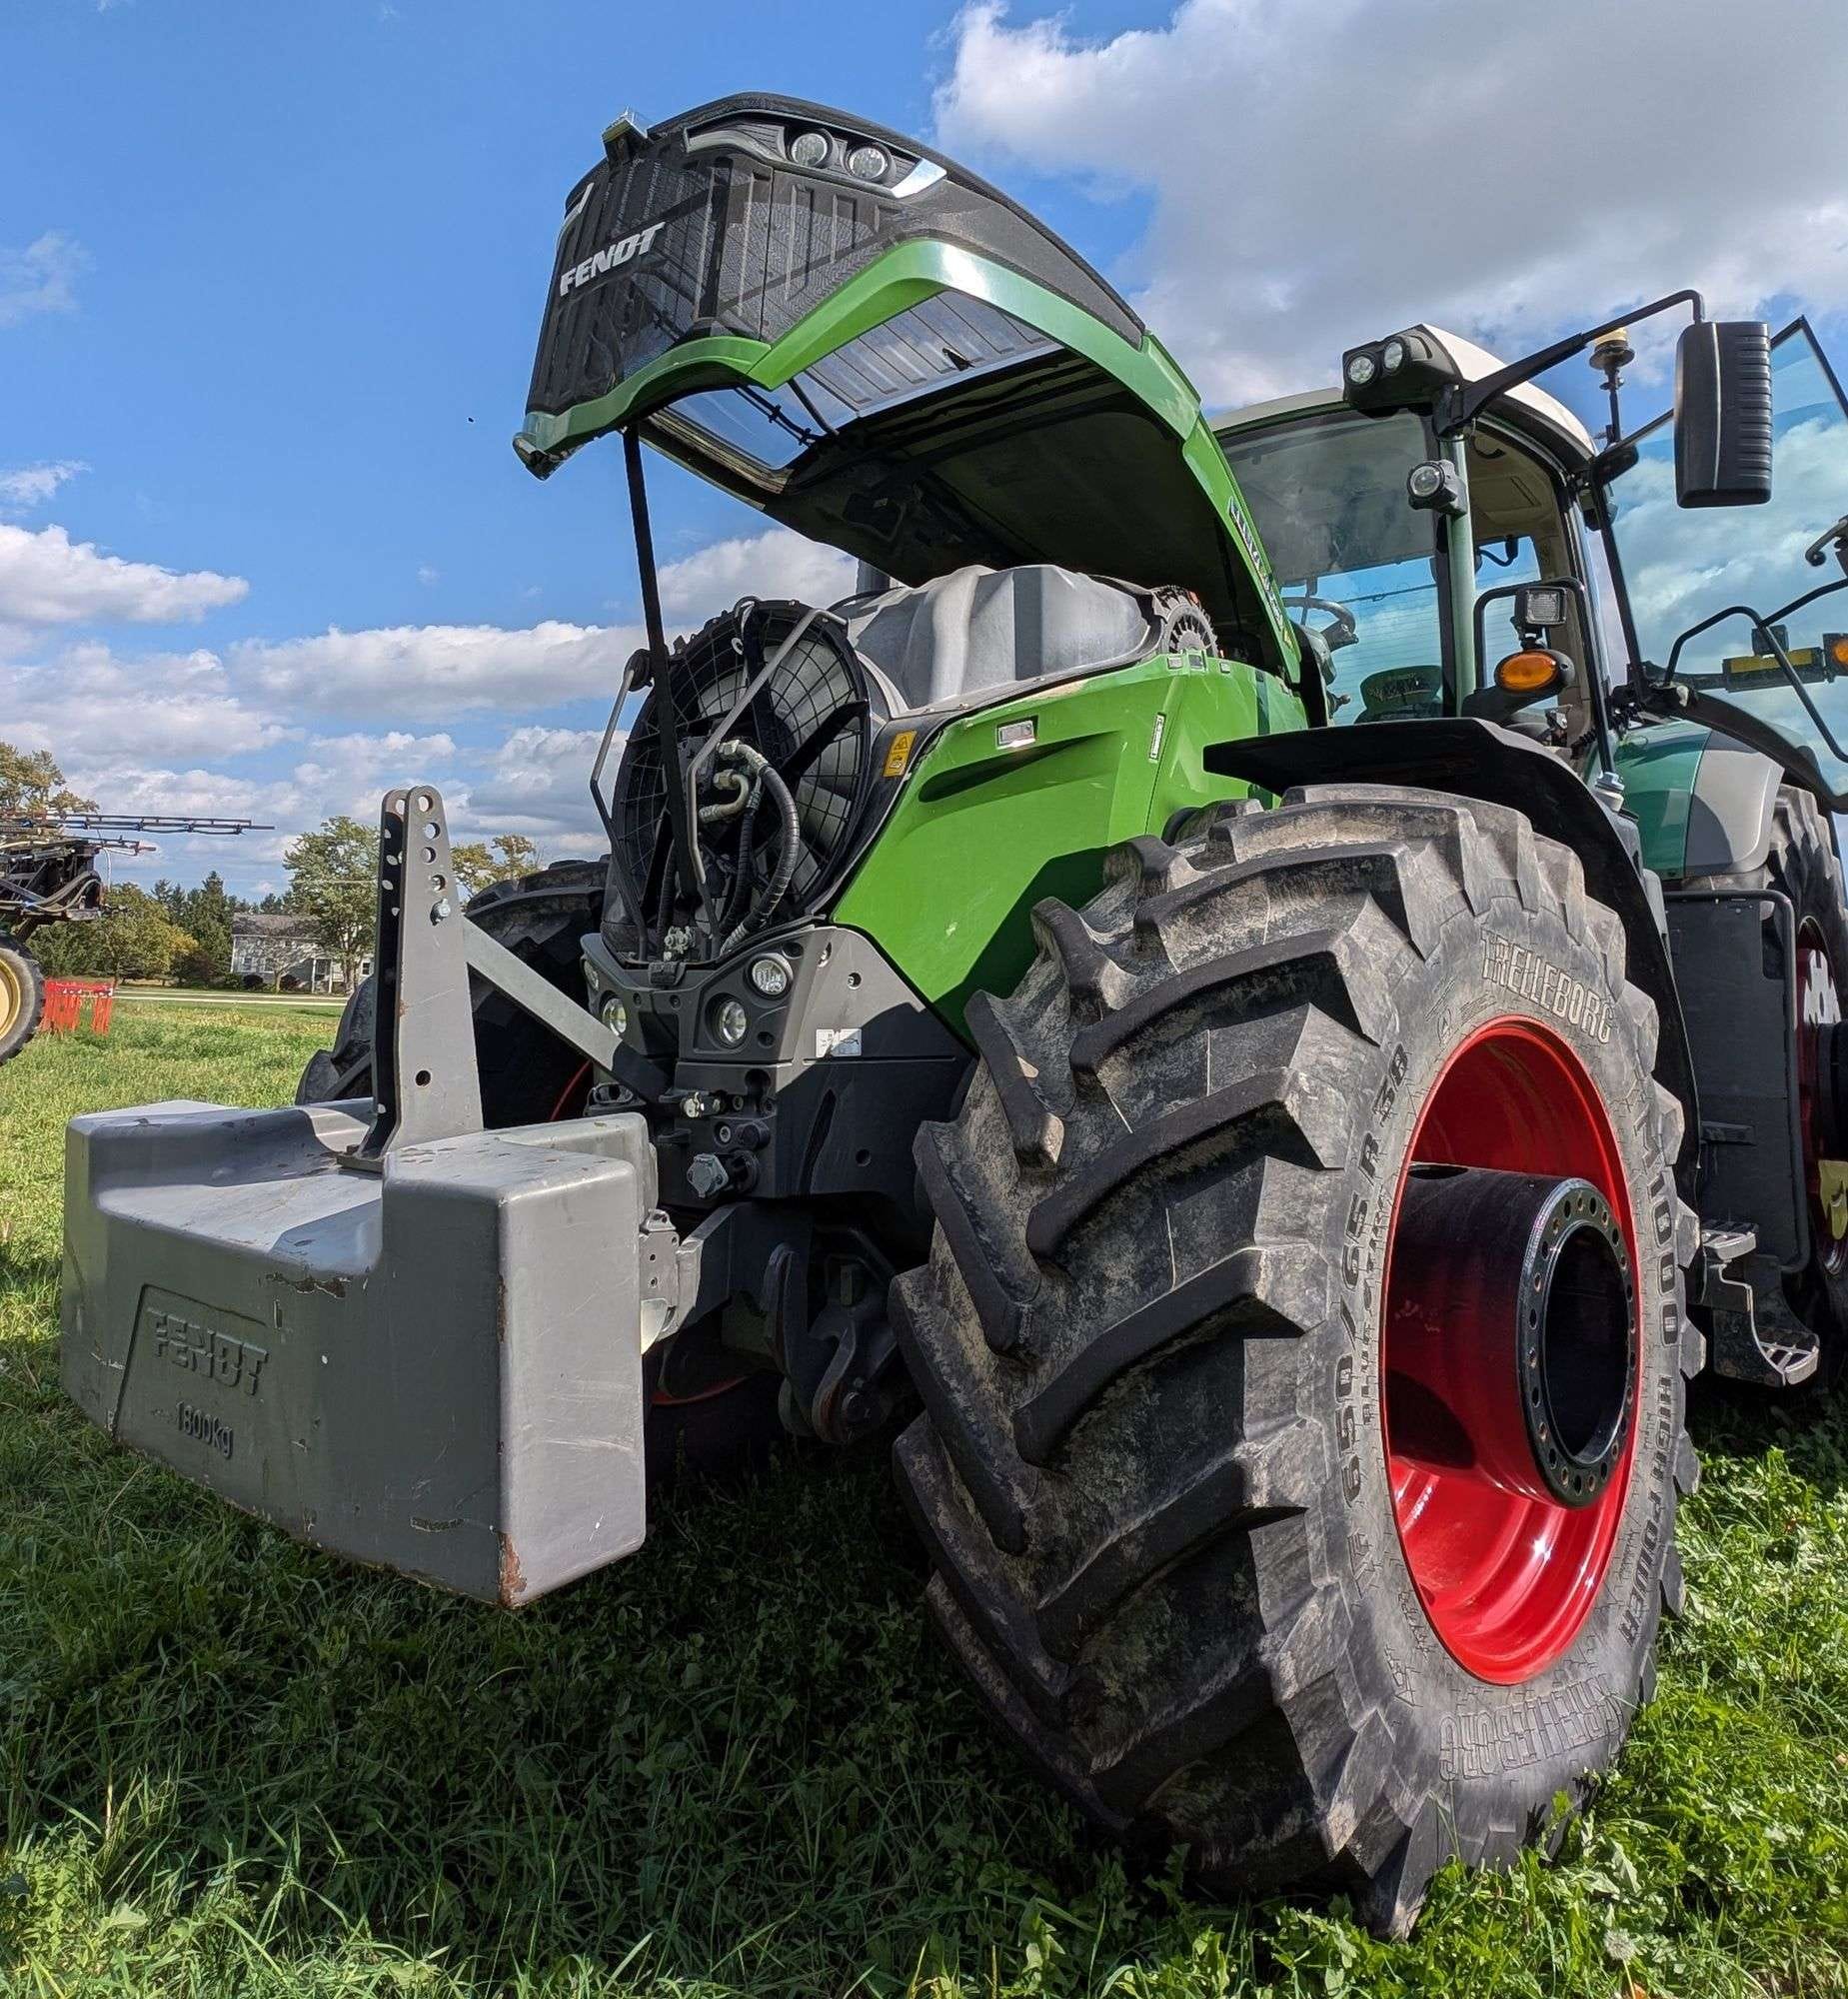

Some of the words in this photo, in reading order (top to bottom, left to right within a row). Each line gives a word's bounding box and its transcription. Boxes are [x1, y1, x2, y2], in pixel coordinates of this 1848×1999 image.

[560, 221, 667, 297] FENDT
[1480, 927, 1614, 1044] TRELLEBORG
[148, 1306, 270, 1396] FENDT
[176, 1400, 234, 1459] 1800kg
[1648, 1374, 1674, 1482] HIGH
[1617, 1489, 1663, 1648] POWER
